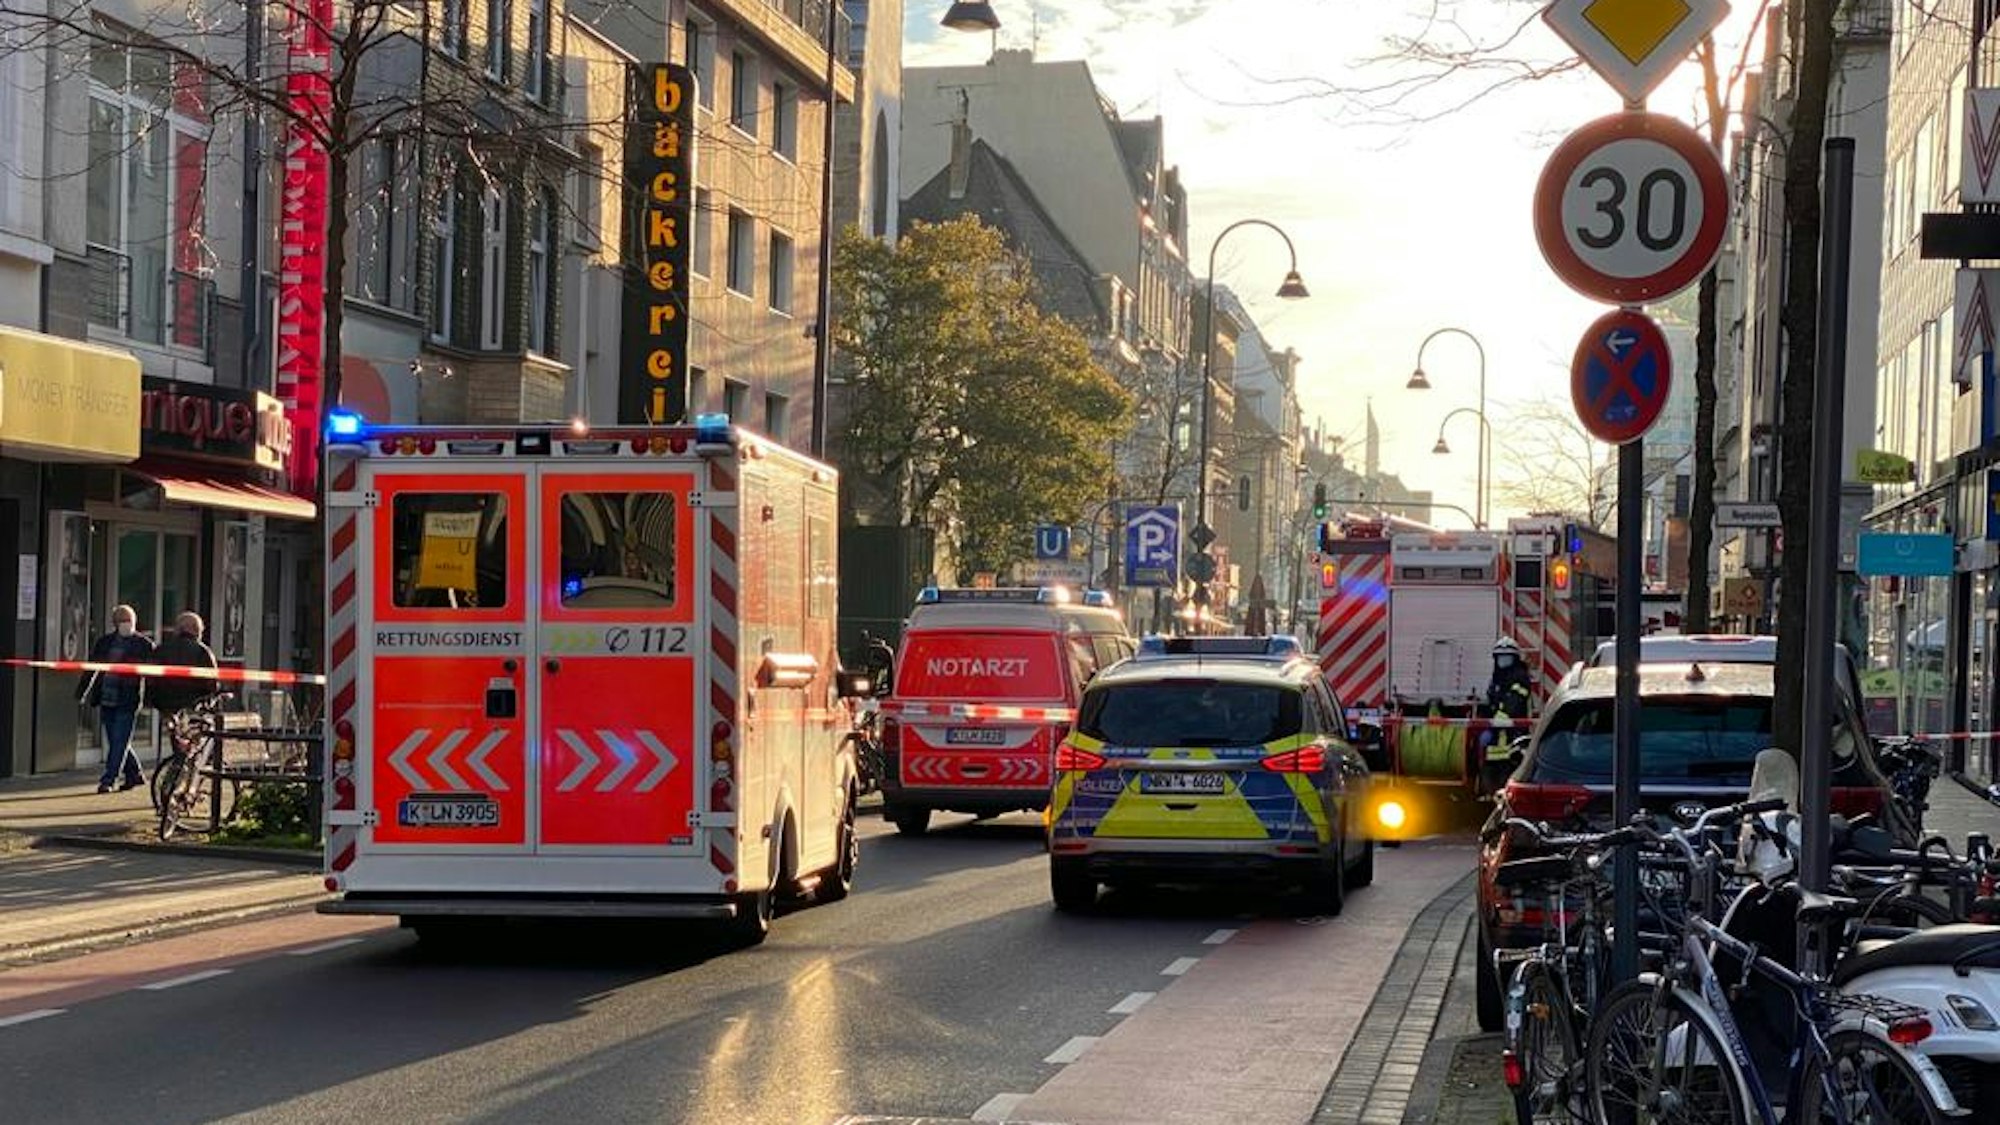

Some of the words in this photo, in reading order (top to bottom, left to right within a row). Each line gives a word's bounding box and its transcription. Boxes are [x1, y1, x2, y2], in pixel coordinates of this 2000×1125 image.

[1576, 167, 1688, 251] 30
[18, 378, 64, 409] MONEY
[70, 384, 129, 416] TRANSFER
[1042, 530, 1062, 555] U
[1138, 524, 1165, 562] P
[376, 631, 522, 647] RETTUNGSDIENST
[640, 627, 687, 653] 112
[926, 658, 1029, 677] NOTARZT
[409, 803, 420, 820] K
[430, 804, 452, 820] LN
[455, 804, 496, 821] 3905
